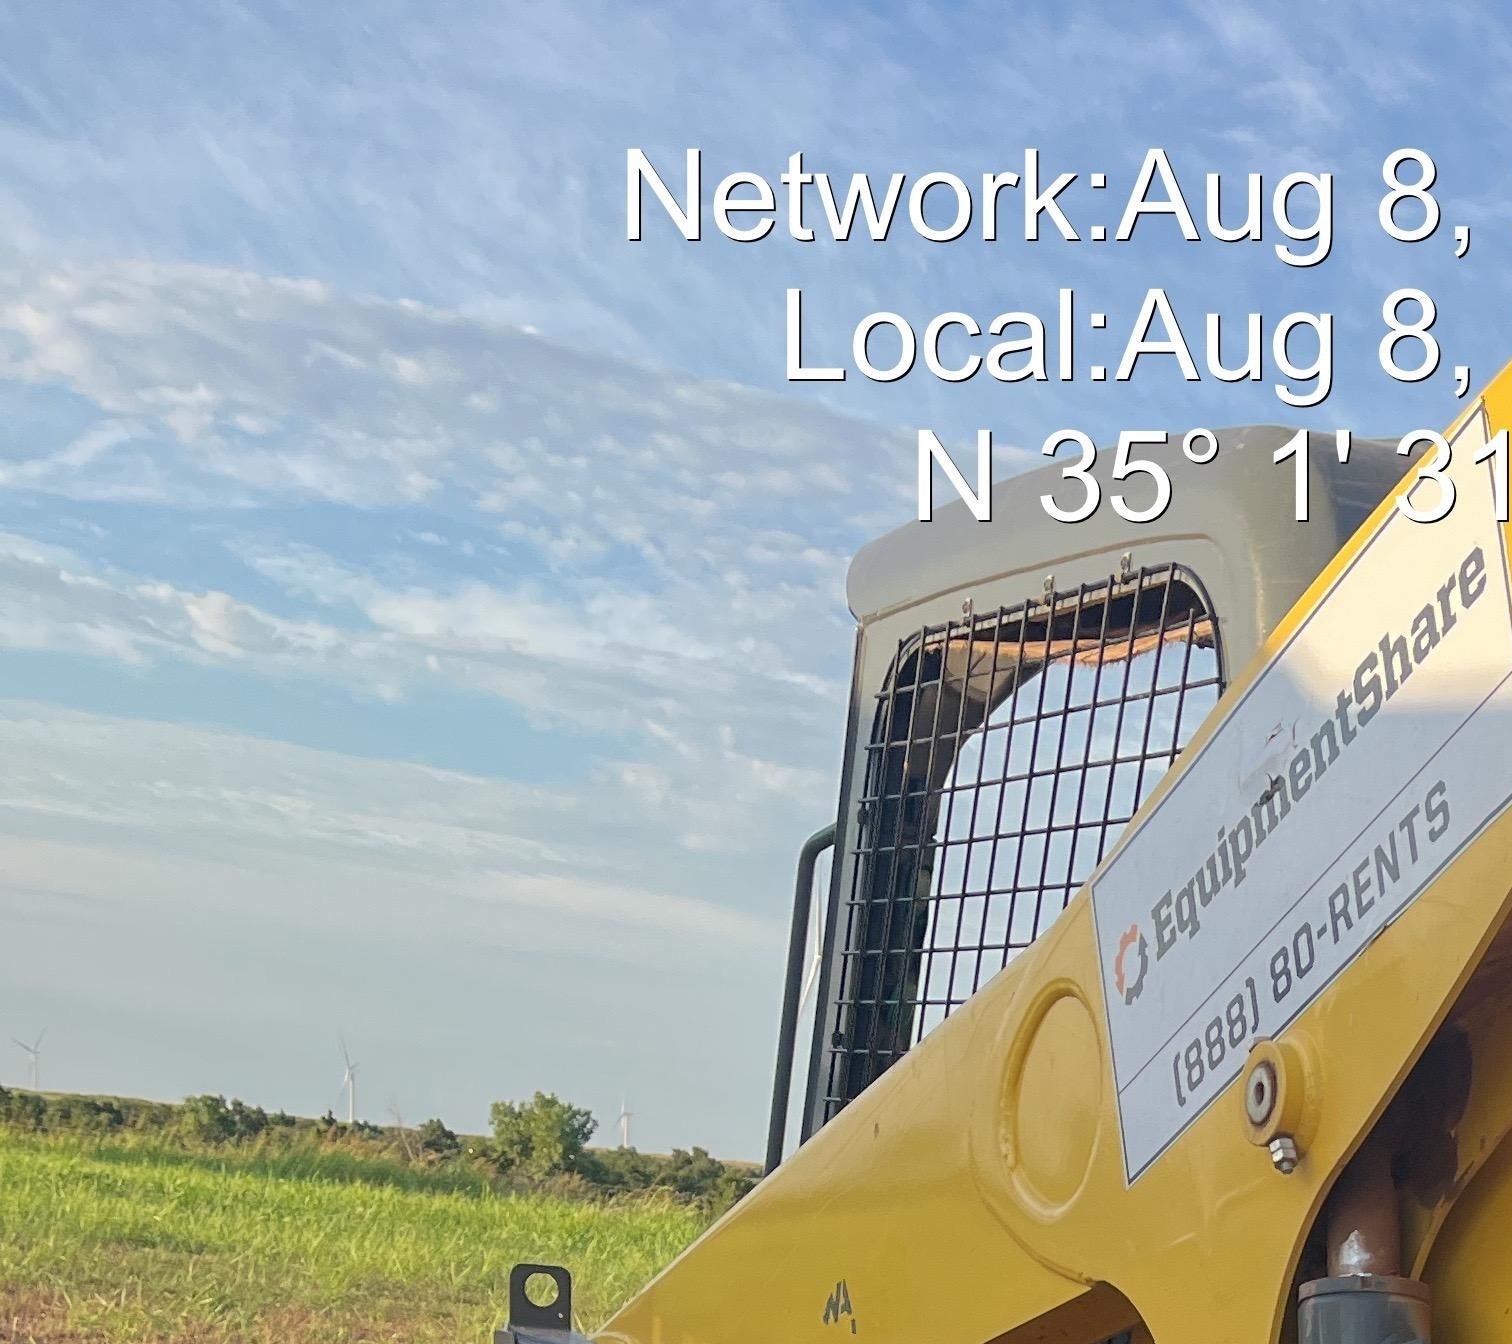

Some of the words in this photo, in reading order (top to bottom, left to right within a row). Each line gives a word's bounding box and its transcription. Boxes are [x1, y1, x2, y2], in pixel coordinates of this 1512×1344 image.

[1147, 546, 1488, 962] EquipmentShare
[1172, 976, 1260, 1108] (888)
[1271, 779, 1452, 1004] 80-RENTS
